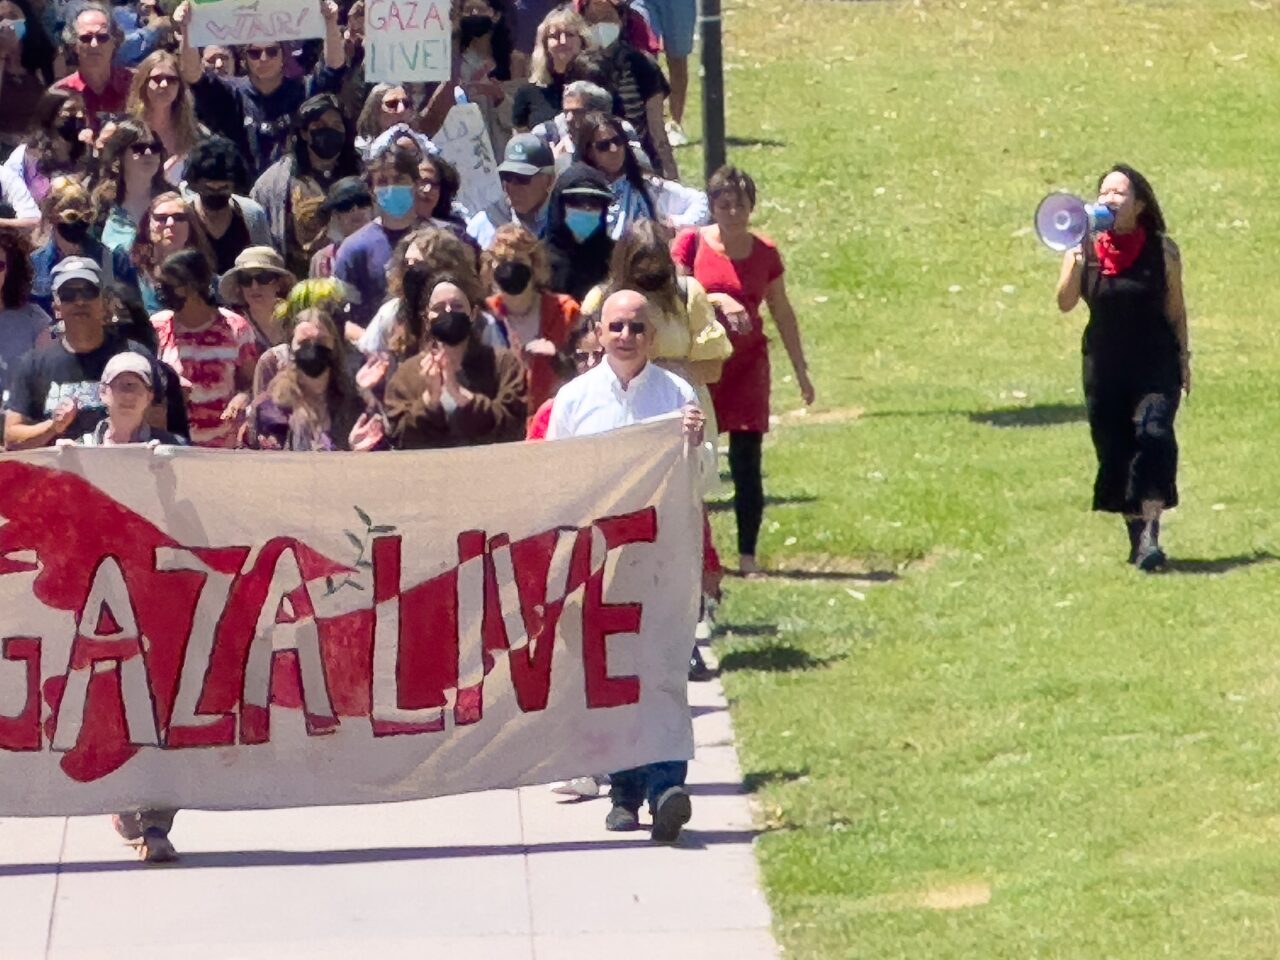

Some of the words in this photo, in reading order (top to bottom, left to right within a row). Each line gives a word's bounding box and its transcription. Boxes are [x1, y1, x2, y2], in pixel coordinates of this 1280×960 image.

[206, 7, 310, 40] WAR!
[368, 0, 445, 32] GAZA
[370, 39, 449, 74] LIVE!
[368, 505, 658, 739] LIVE
